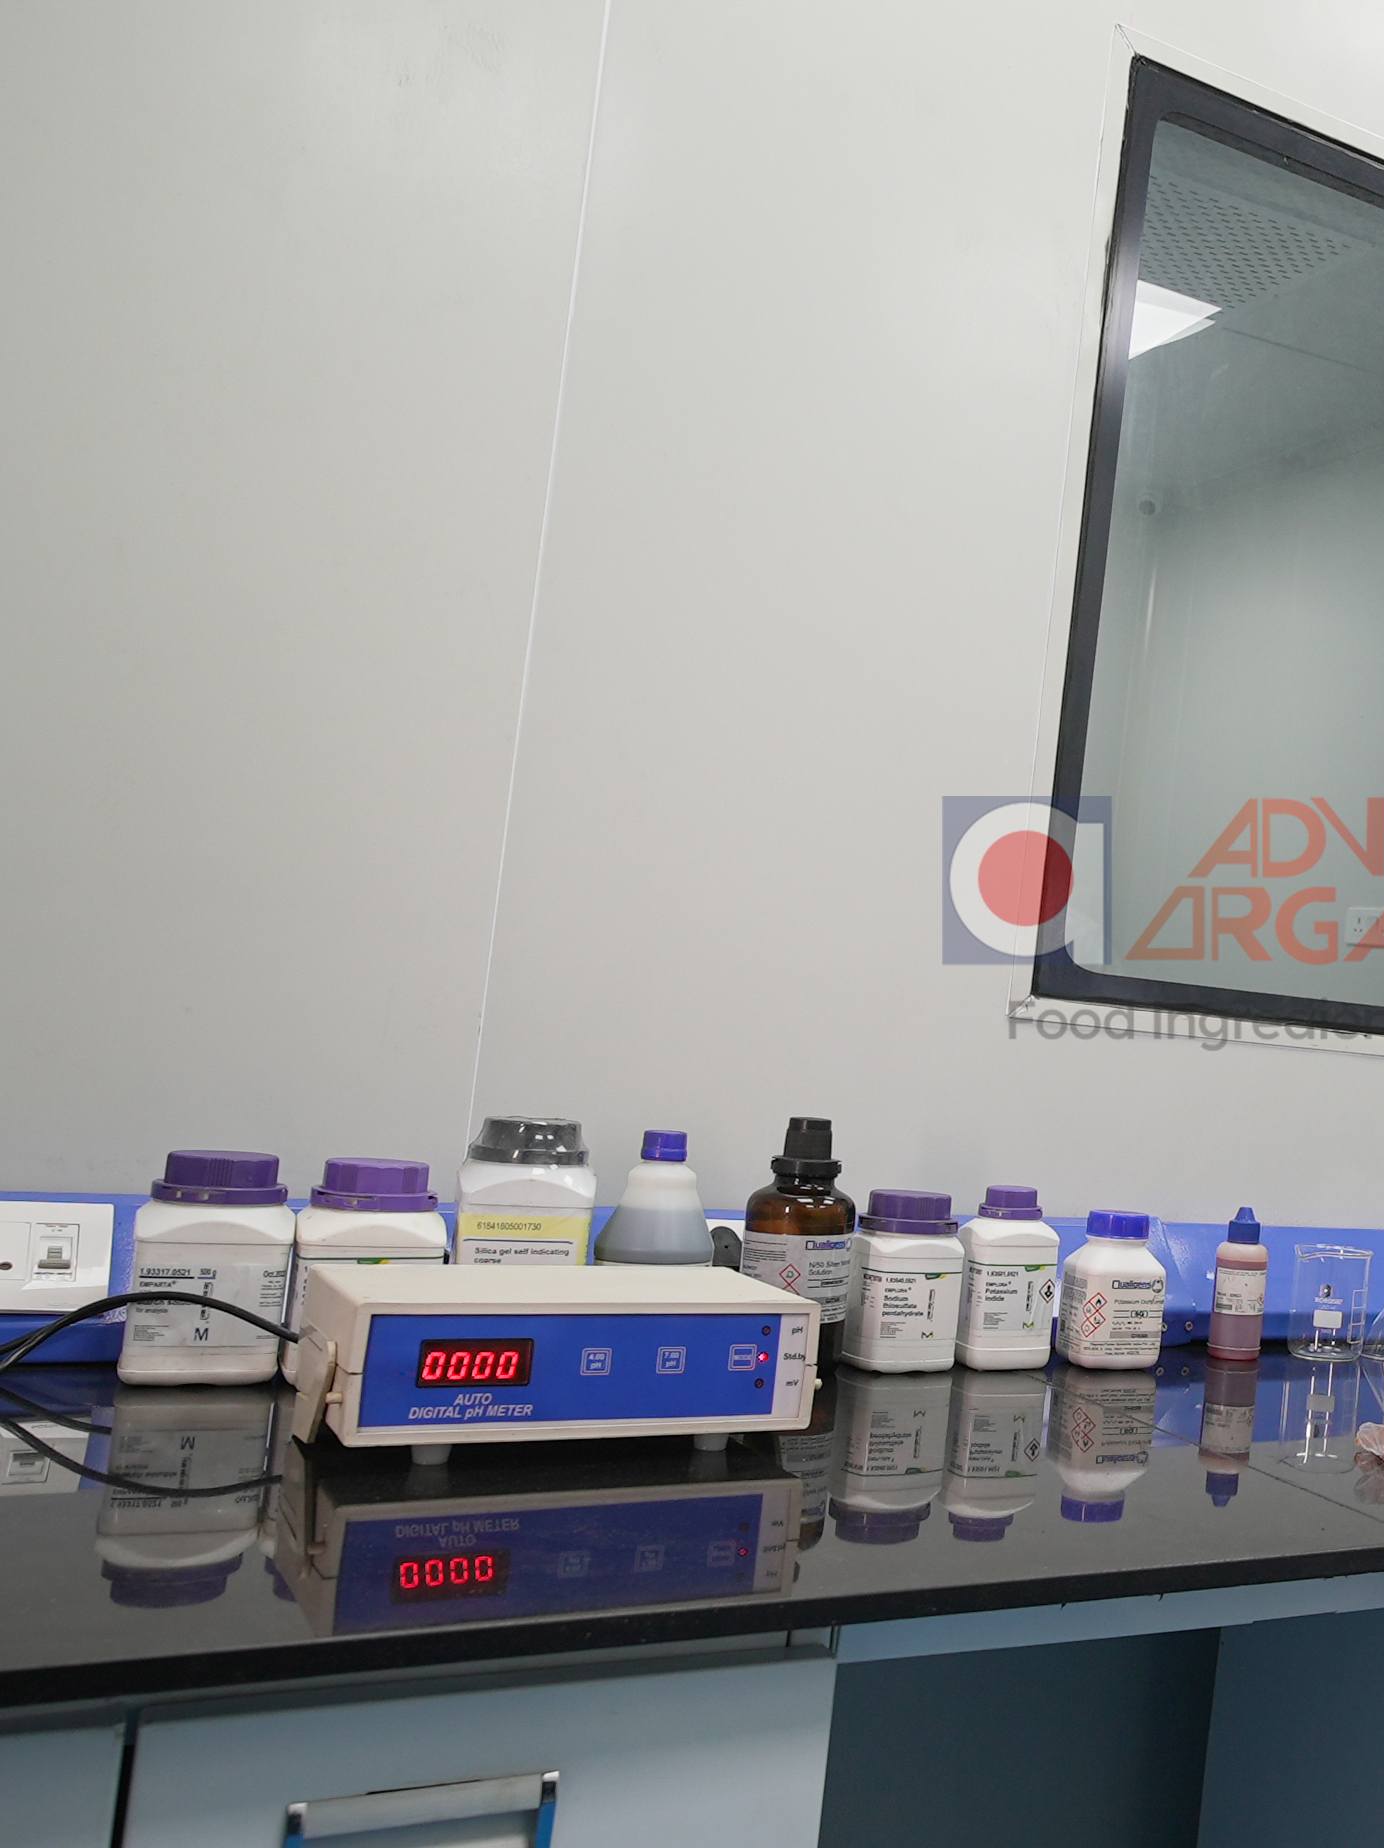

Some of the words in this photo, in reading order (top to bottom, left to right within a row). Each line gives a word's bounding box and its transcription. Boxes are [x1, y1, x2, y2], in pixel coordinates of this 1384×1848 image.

[499, 1248, 511, 1256] gel
[530, 1247, 569, 1257] indicating
[791, 1326, 804, 1336] pH
[421, 1351, 520, 1380] 0000
[453, 1392, 493, 1406] AUTO
[408, 1407, 462, 1420] DIGITAL
[464, 1407, 483, 1420] pH
[485, 1404, 534, 1417] METER
